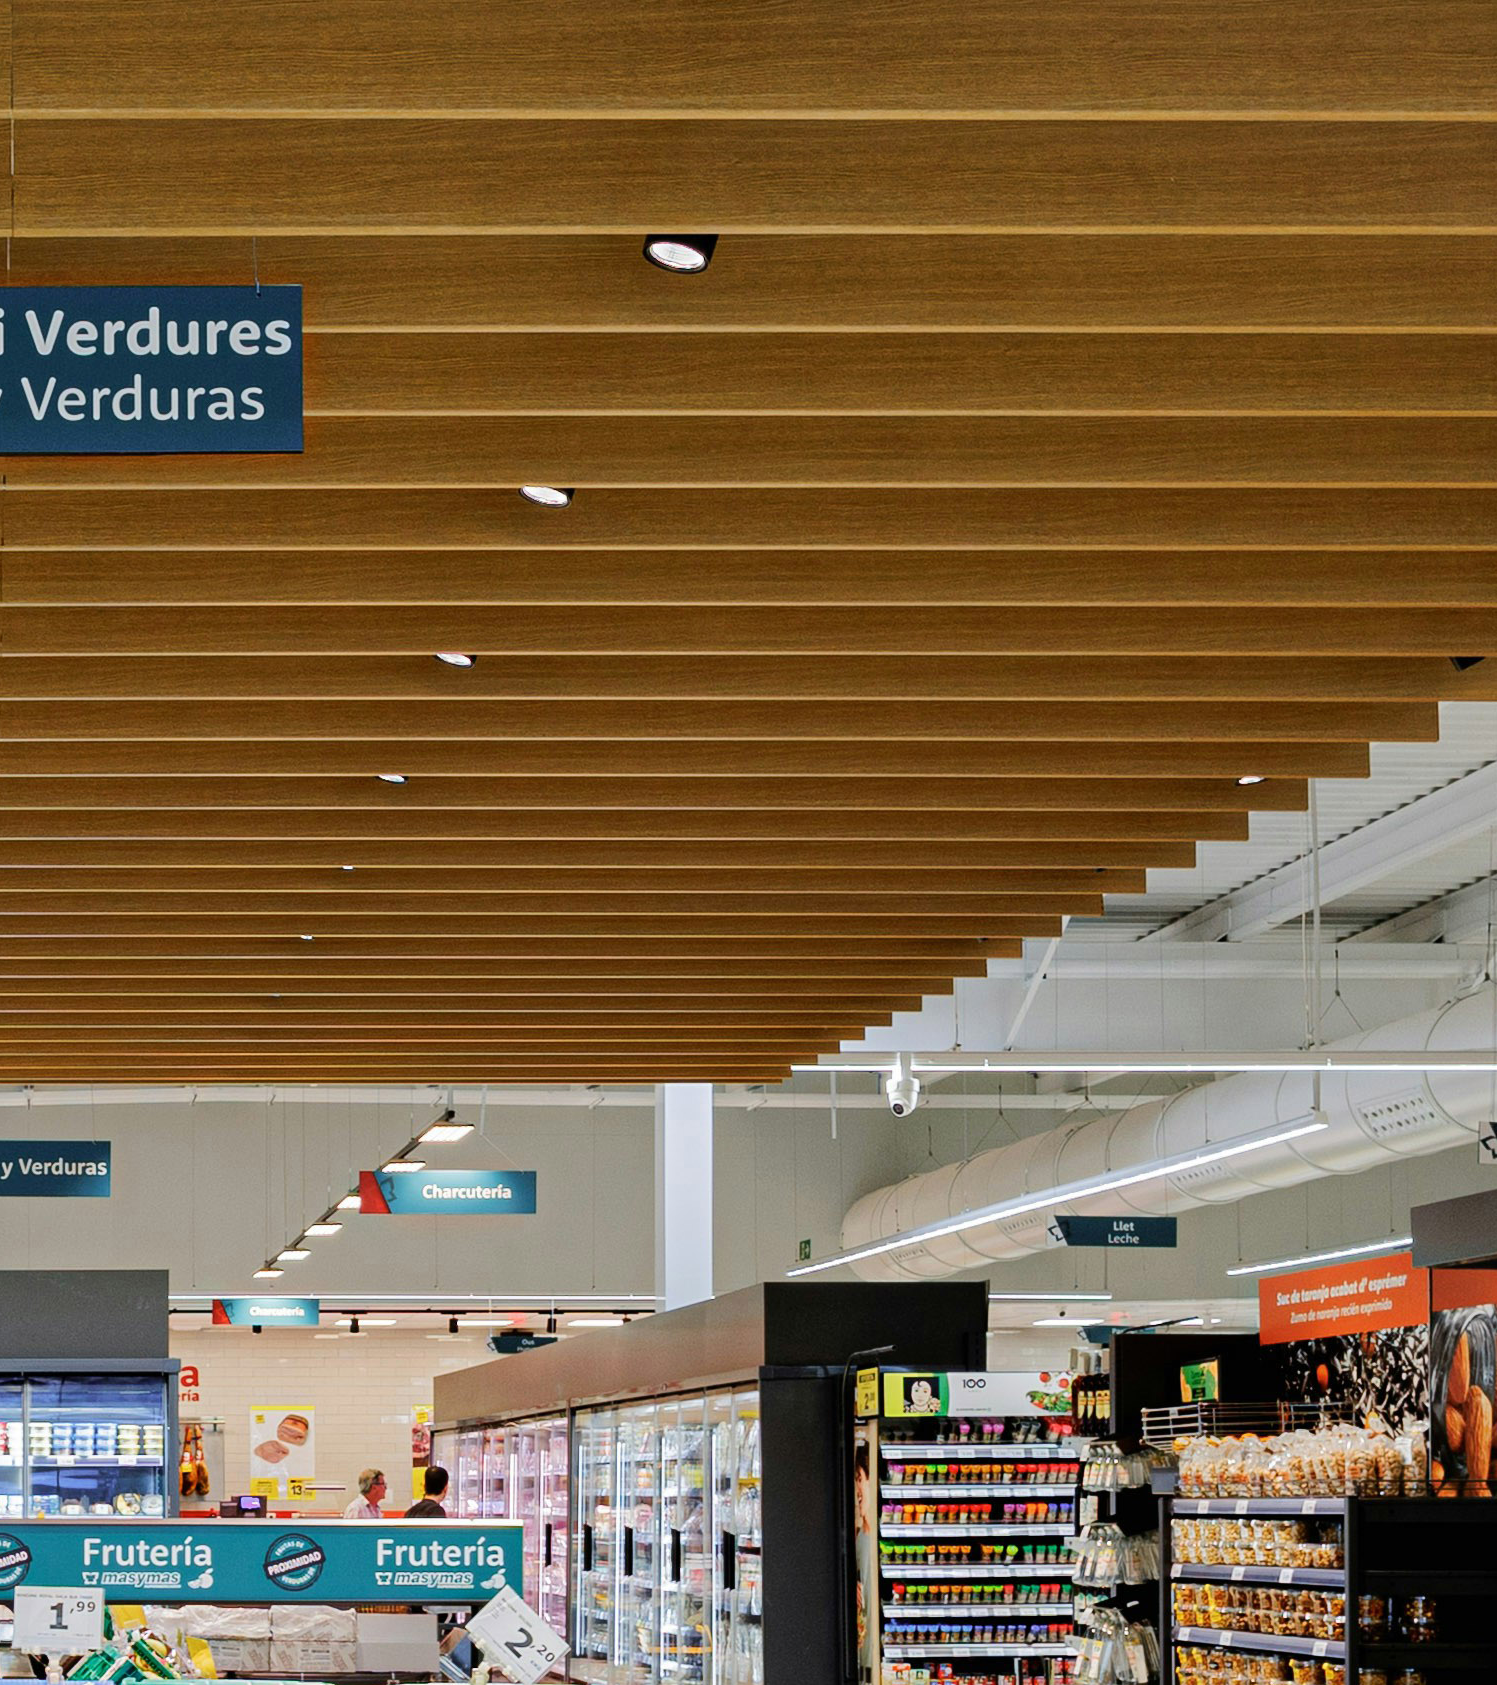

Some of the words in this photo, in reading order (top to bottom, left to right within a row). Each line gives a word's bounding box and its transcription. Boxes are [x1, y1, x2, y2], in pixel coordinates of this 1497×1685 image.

[26, 308, 292, 357] Verdures
[22, 375, 265, 421] Verduras
[0, 1161, 15, 1180] y
[18, 1155, 108, 1178] Verduras
[421, 1182, 512, 1200] Charcutería
[1107, 1233, 1140, 1246] Leche
[1112, 1221, 1135, 1233] Llet
[1277, 1292, 1289, 1306] Suc
[83, 1536, 212, 1567] Frutería
[267, 1551, 322, 1576] PROXIMIDAD
[376, 1536, 505, 1567] Frutería
[101, 1571, 181, 1588] masymas
[394, 1571, 474, 1588] masymas
[49, 1601, 96, 1630] 1,99
[504, 1627, 556, 1663] 2,20
